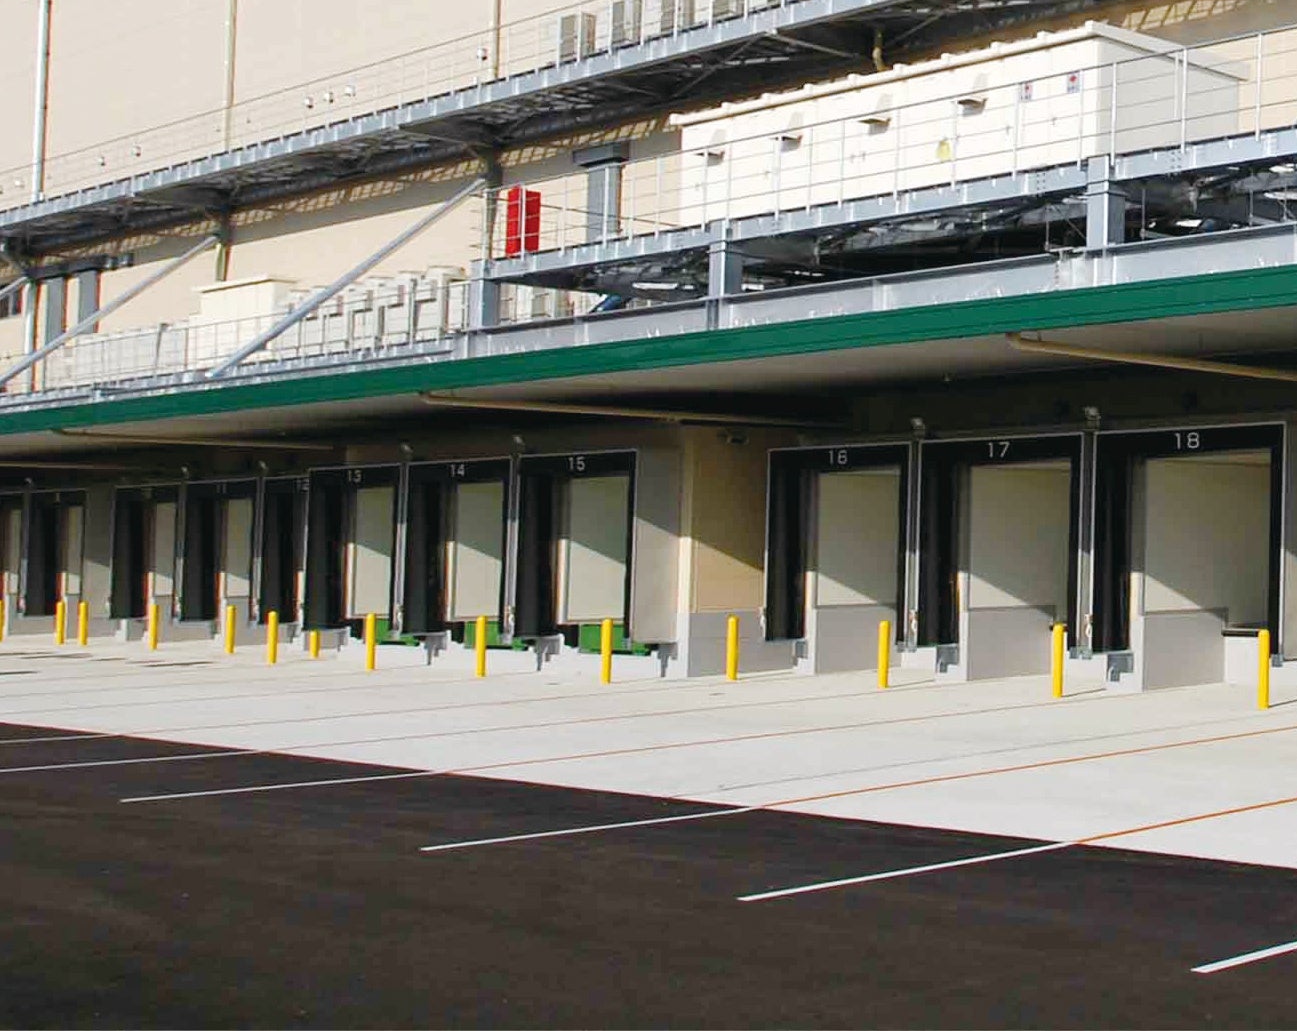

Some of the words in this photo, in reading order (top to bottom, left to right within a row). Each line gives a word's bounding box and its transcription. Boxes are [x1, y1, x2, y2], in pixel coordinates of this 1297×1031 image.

[1173, 431, 1201, 449] 18
[827, 449, 848, 465] 16
[986, 441, 1010, 458] 17
[449, 464, 466, 477] 14
[567, 456, 586, 471] 15
[347, 469, 362, 483] 13
